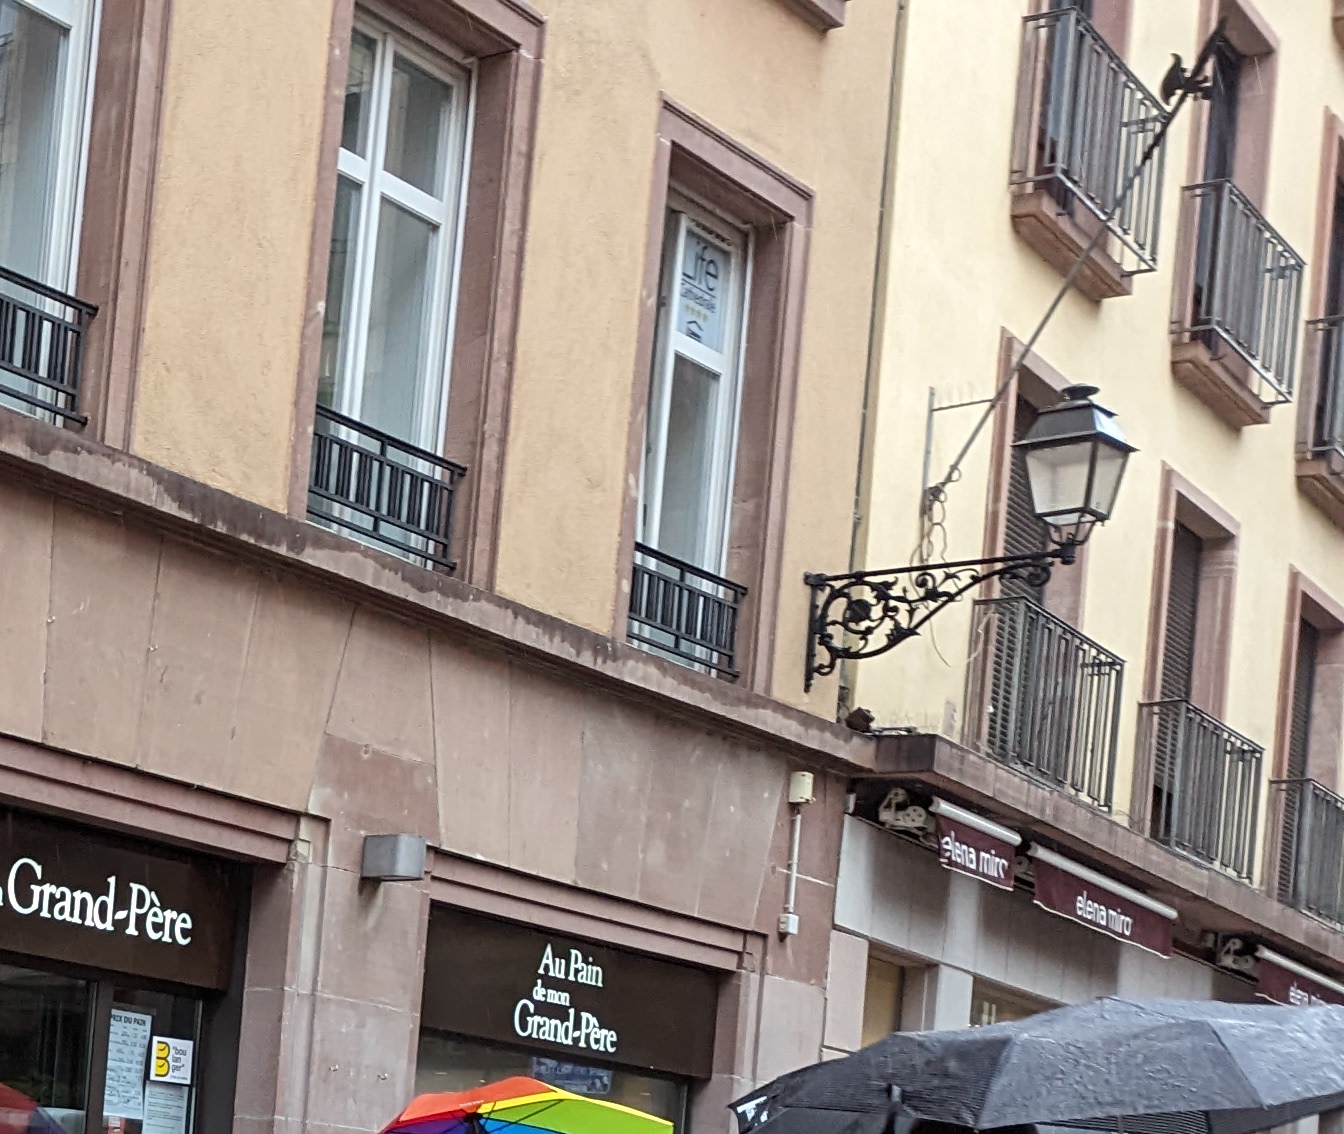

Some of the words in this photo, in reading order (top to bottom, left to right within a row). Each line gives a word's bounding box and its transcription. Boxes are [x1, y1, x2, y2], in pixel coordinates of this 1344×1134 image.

[941, 830, 977, 870] elena
[7, 857, 193, 947] Grand-Père
[1076, 890, 1108, 926] elena
[537, 943, 566, 979] Au
[567, 948, 604, 988] Pain
[532, 979, 546, 1002] de
[546, 988, 570, 1007] mon
[514, 999, 618, 1053] Grand-Père
